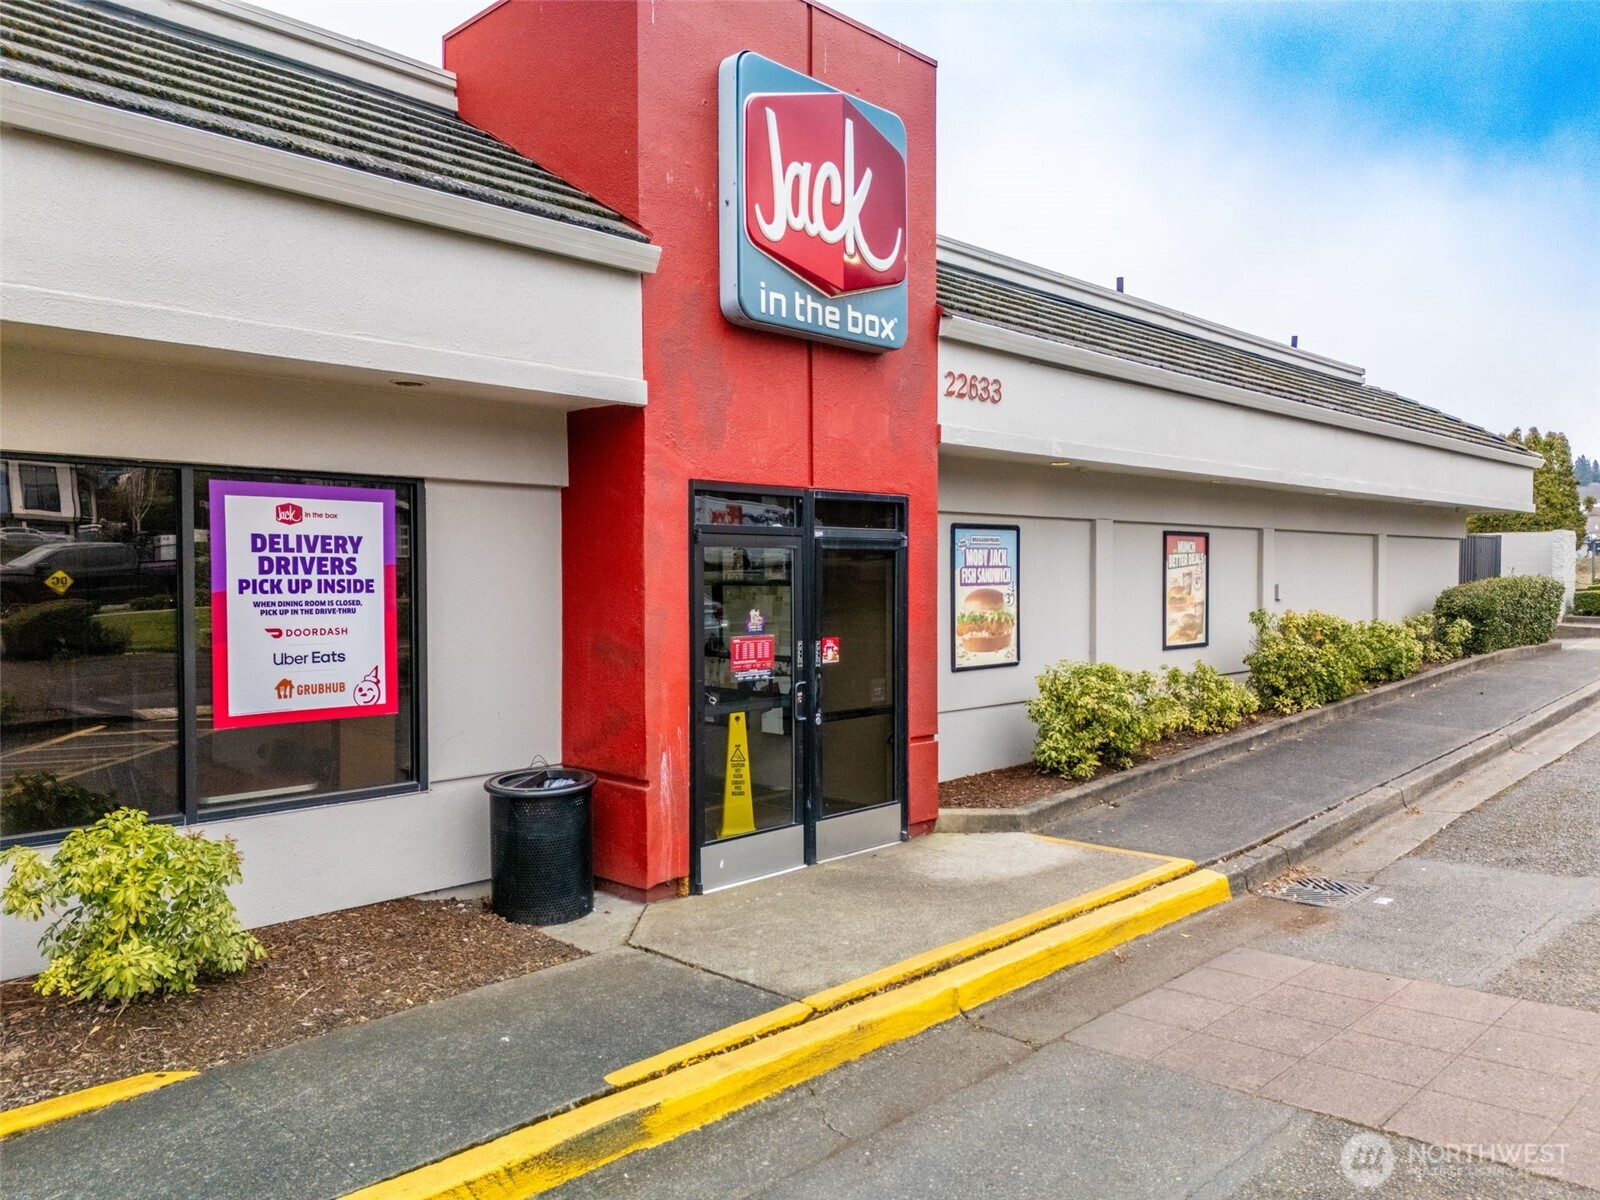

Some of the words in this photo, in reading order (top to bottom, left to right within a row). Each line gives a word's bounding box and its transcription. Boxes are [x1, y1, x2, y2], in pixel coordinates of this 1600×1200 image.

[755, 106, 902, 271] Jack
[760, 281, 787, 318] in
[794, 291, 840, 330] the
[847, 304, 895, 341] box
[943, 370, 1003, 404] 22633
[277, 505, 301, 522] Jack
[304, 511, 310, 519] in
[312, 511, 323, 519] the
[325, 511, 338, 519] box
[250, 533, 363, 554] DELIVERY
[257, 556, 357, 575] DRIVERS
[966, 549, 987, 566] MOBY
[989, 549, 1007, 566] JACK
[1168, 554, 1188, 568] BETTER
[1188, 553, 1204, 565] DEALS
[961, 568, 976, 584] FISH
[977, 568, 1010, 583] SANDWICH
[238, 579, 283, 594] PICK
[287, 579, 312, 594] UP
[316, 579, 375, 594] INSIDE
[252, 600, 276, 608] WHEN
[277, 600, 303, 608] DINING
[304, 600, 327, 608] ROOM
[335, 600, 363, 608] CLOSED,
[260, 609, 278, 617] PICK
[279, 609, 290, 617] UP
[300, 608, 314, 616] THE
[315, 607, 357, 616] DRIVE-THRU
[285, 627, 349, 638] DOORDASH
[273, 653, 309, 666] Uber
[311, 651, 346, 664] Eats
[296, 681, 346, 696] GRUBHUB
